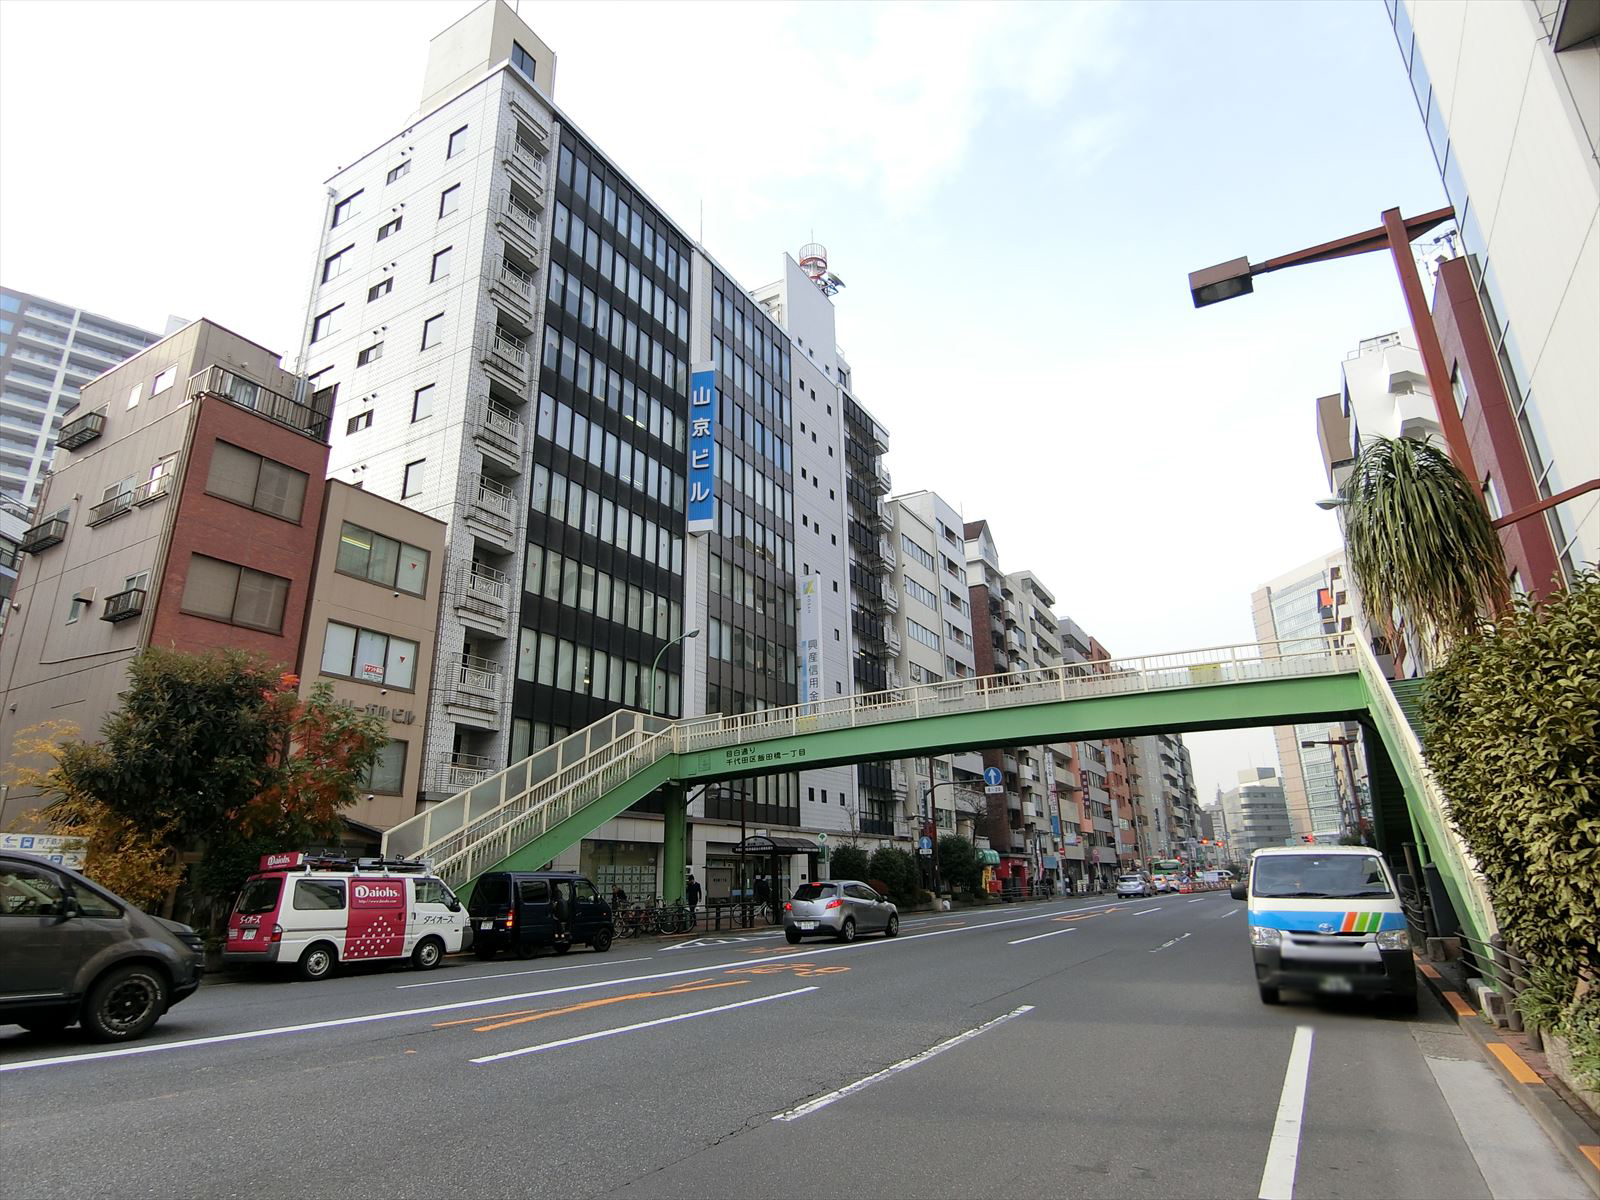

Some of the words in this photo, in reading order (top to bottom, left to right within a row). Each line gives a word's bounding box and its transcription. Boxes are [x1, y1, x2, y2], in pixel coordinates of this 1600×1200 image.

[690, 386, 711, 502] 山京ビル
[726, 747, 756, 758] 目白通り
[726, 748, 806, 766] 千代田区飯田橋一丁目
[355, 885, 400, 898] Daiohs
[423, 915, 455, 925] ダイオーズ
